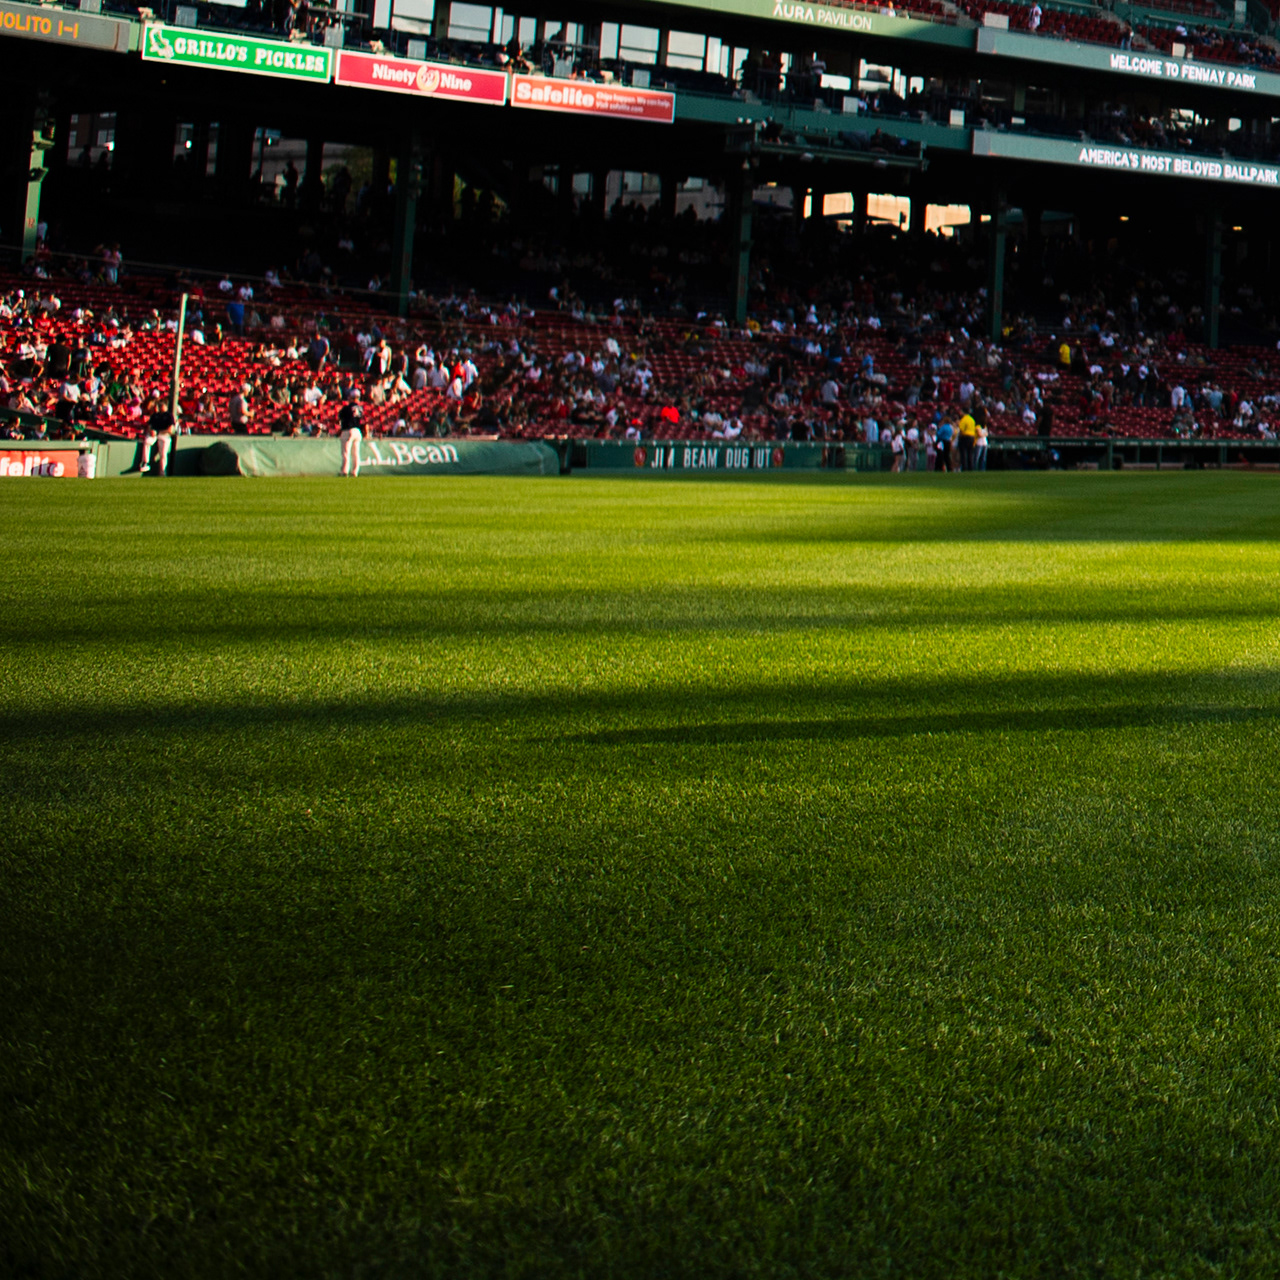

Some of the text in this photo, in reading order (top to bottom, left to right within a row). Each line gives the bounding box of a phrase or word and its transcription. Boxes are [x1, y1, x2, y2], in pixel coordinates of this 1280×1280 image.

[817, 9, 873, 30] PAVILION
[174, 37, 325, 73] GRILLO'S PICKLES
[372, 63, 417, 86] Ninety
[440, 73, 472, 91] Nine
[1110, 53, 1256, 88] WELCOME TO FENWAY PARK
[516, 82, 595, 107] Safelite
[1079, 148, 1279, 184] AMERICA'S MOST BELOVED BALLPARK
[683, 447, 718, 468] BEAM
